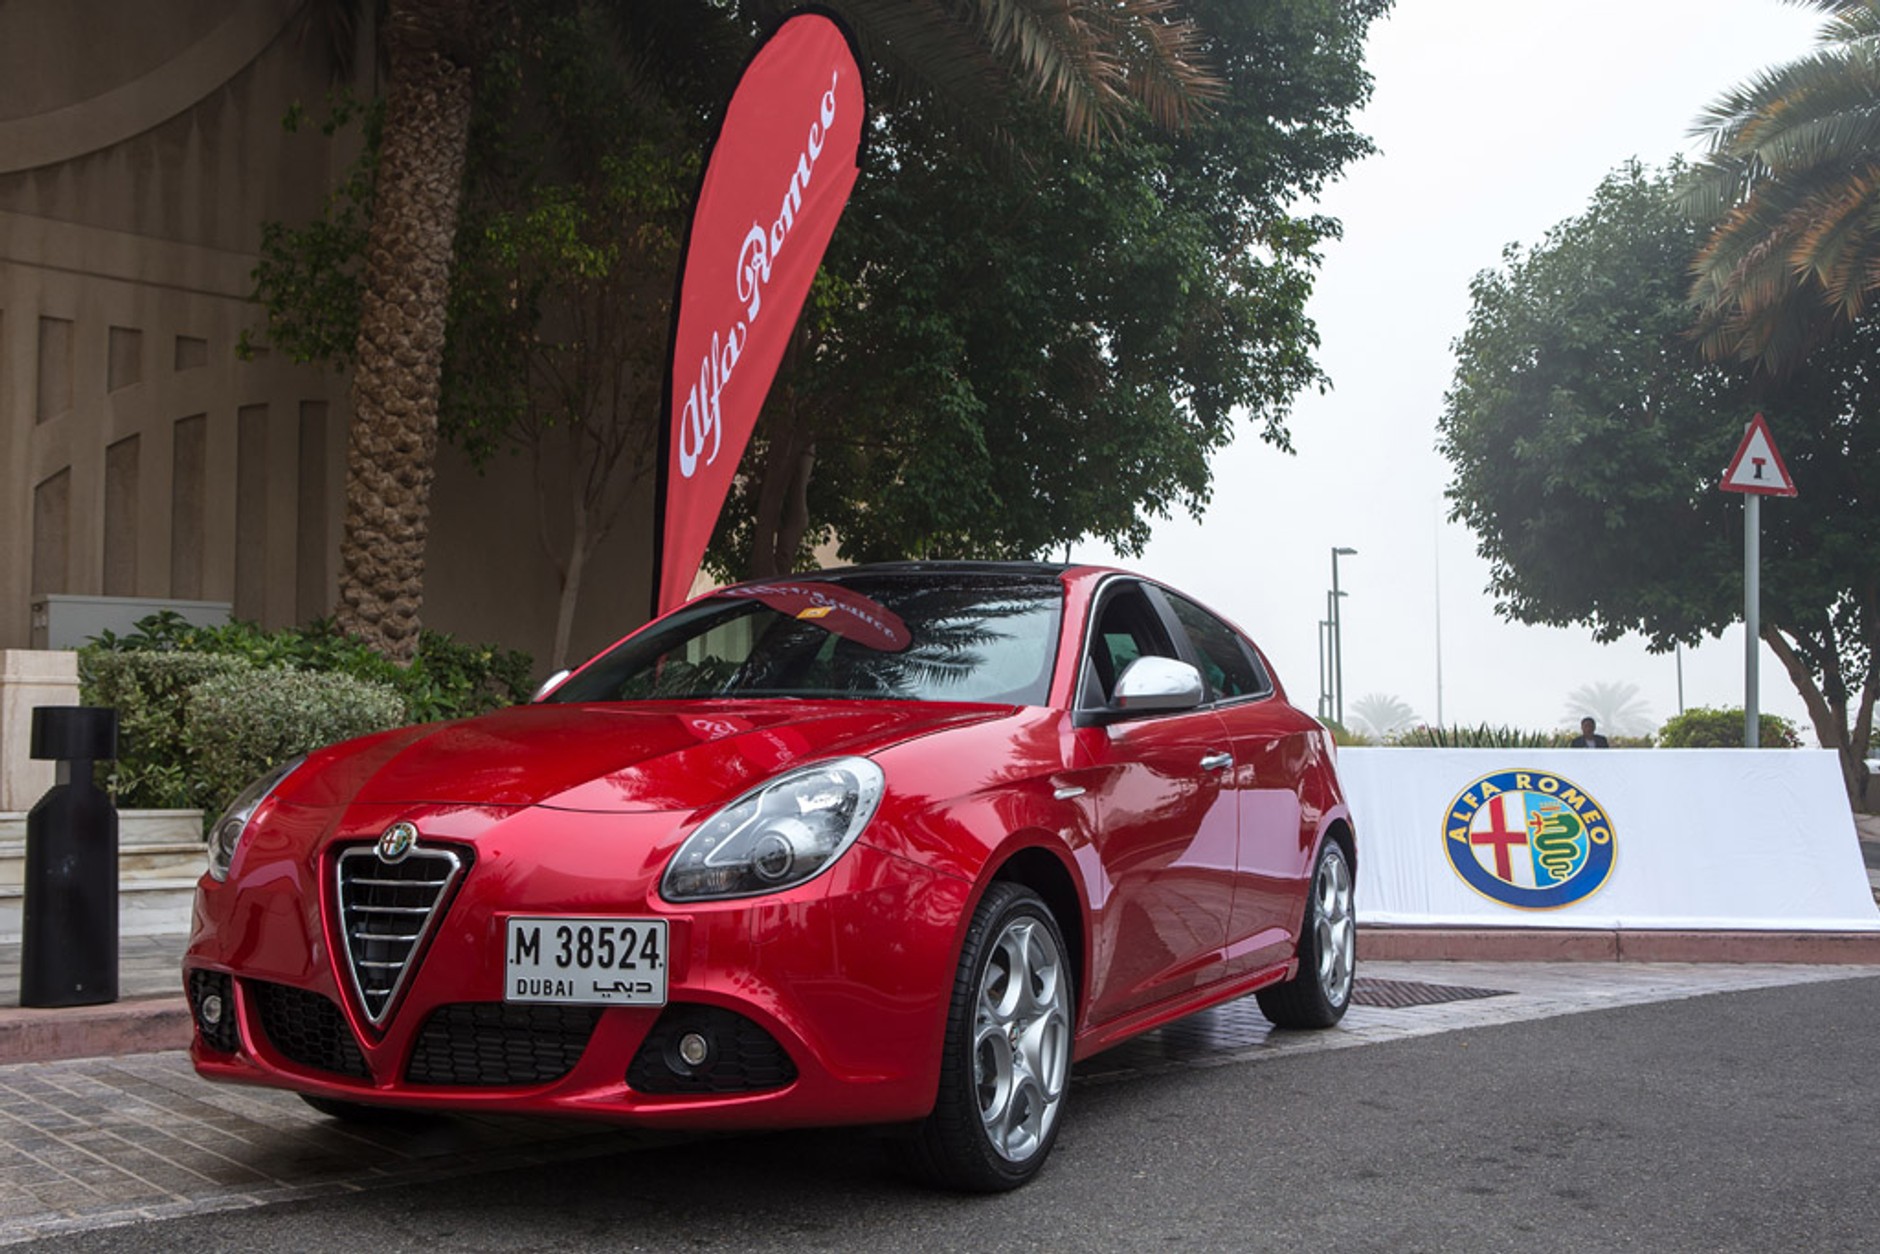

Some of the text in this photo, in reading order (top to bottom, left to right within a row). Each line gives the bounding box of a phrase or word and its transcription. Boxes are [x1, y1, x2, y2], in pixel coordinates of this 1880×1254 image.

[679, 70, 838, 478] Alfa Romeo
[1448, 773, 1610, 845] ALFA ROMEO
[515, 925, 660, 970] M 38524
[517, 978, 574, 997] DUBAI
[593, 980, 653, 998] دبي
